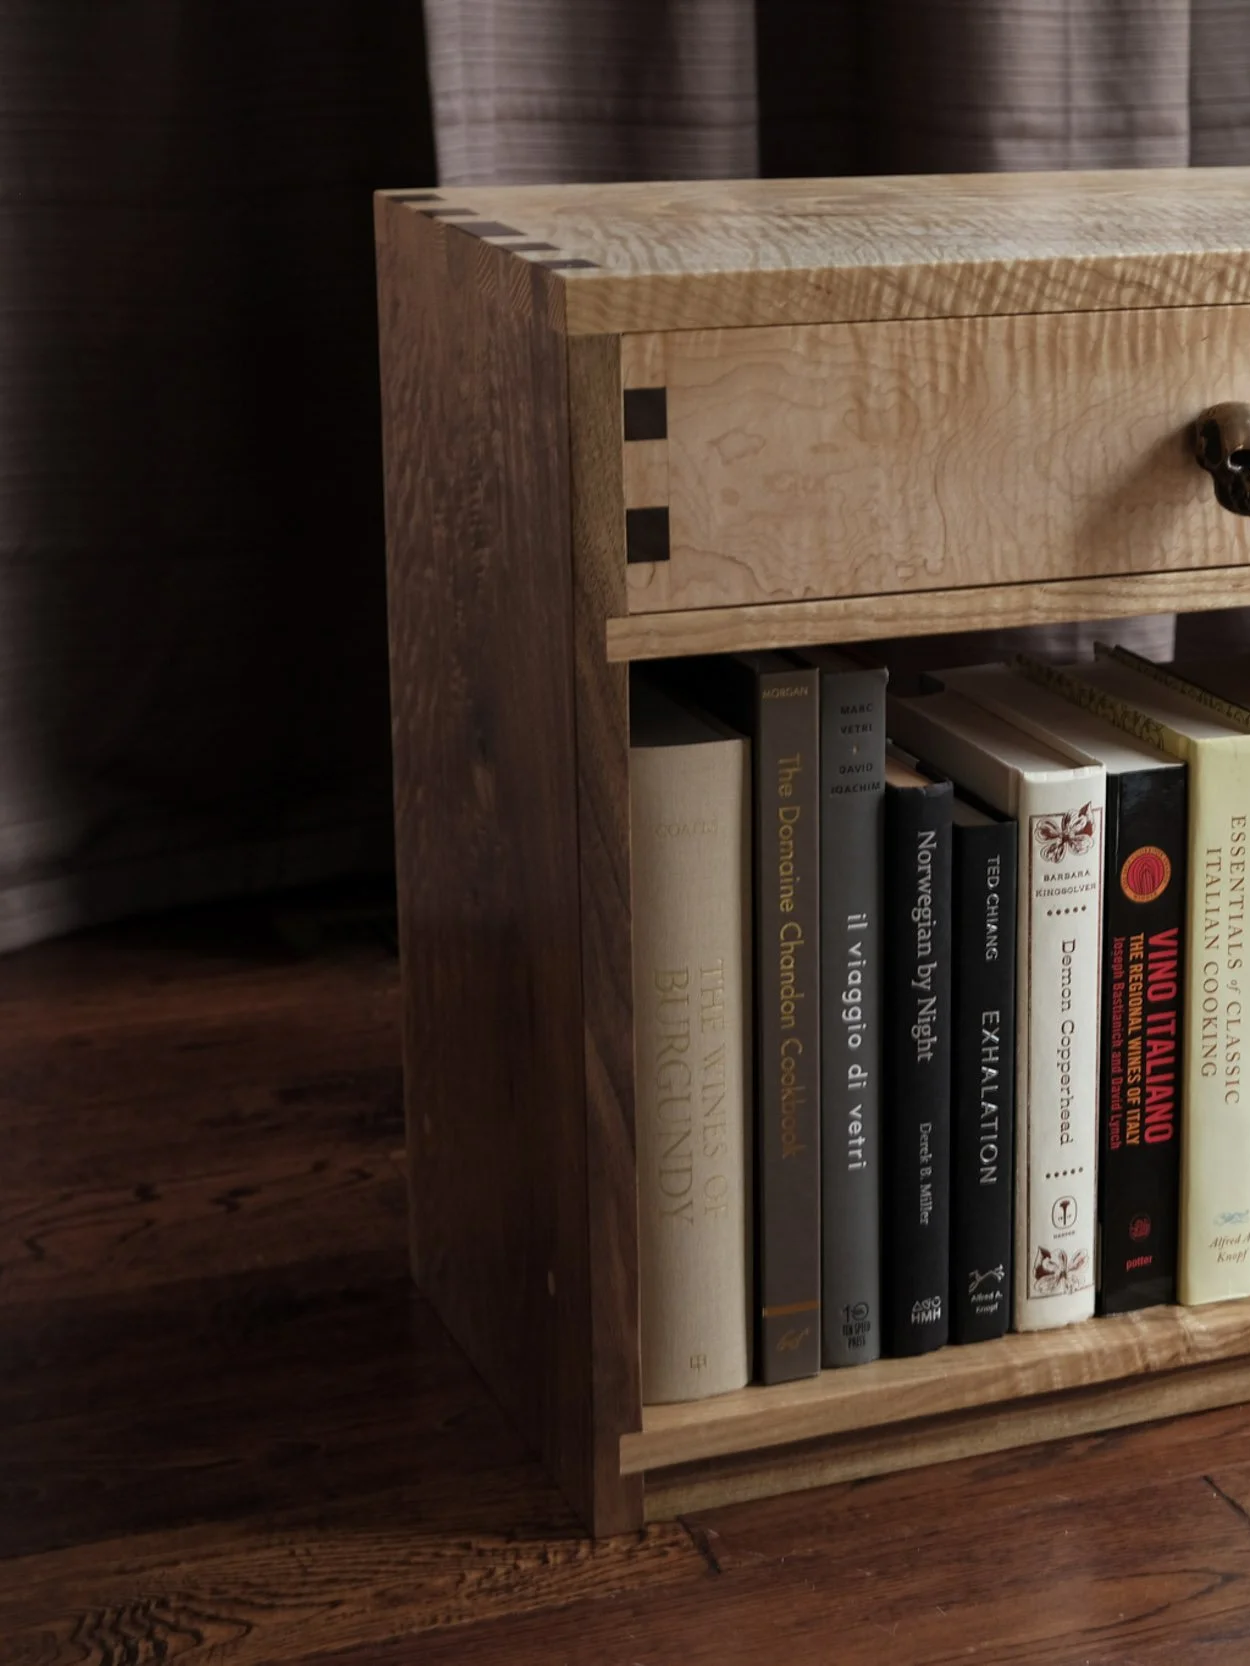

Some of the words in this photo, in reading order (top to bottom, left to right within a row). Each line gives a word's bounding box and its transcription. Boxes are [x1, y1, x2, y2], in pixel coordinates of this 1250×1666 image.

[762, 686, 808, 699] MORGAN
[840, 702, 873, 716] MARC
[840, 723, 872, 735] VETRI
[777, 753, 802, 799] The
[830, 781, 881, 795] JOACHIM
[839, 763, 873, 776] DAVID
[779, 805, 802, 914] Domaine
[987, 855, 1000, 888] TED
[1043, 870, 1091, 882] BARBARA
[911, 830, 937, 958] Norwegian
[1035, 882, 1097, 897] KINGSOLVER
[1202, 848, 1223, 950] ITALIAN
[1226, 815, 1247, 970] ESSENTIALS
[848, 913, 868, 931] il
[985, 892, 999, 962] CHIANG
[1112, 936, 1125, 980] Joseph
[1129, 933, 1145, 962] THE
[1146, 927, 1179, 1001] VINO
[701, 958, 725, 1034] THE
[780, 921, 805, 1030] Chandon
[842, 941, 868, 1048] viaggio
[911, 961, 937, 991] by
[1061, 939, 1076, 1012] Demon
[1226, 978, 1241, 994] of
[1111, 981, 1125, 1049] Bastianich
[1127, 963, 1144, 1036] REGIONAL
[1200, 960, 1221, 1078] COOKING
[911, 995, 937, 1063] Night
[1111, 1051, 1122, 1073] and
[1126, 1036, 1142, 1084] WINES
[1224, 1000, 1242, 1105] CLASSIC
[654, 966, 694, 1226] BURGUNDY
[781, 1038, 806, 1160] Cookbook
[848, 1063, 868, 1091] di
[979, 1010, 1000, 1185] EXHALATION
[1057, 1020, 1075, 1146] Copperhead
[1111, 1077, 1123, 1111] David
[1127, 1087, 1141, 1105] OF
[1144, 1010, 1177, 1144] ITALIANO
[702, 1043, 728, 1158] WINES
[848, 1104, 868, 1171] vetri
[920, 1122, 932, 1164] Derek
[1109, 1112, 1122, 1150] Lynch
[1126, 1106, 1140, 1146] ITALY
[704, 1174, 729, 1221] OF
[920, 1168, 932, 1182] B.
[919, 1183, 932, 1225] Miller
[1208, 1232, 1240, 1249] Alfred
[1216, 1249, 1248, 1264] Knopf
[911, 1308, 941, 1325] HMH
